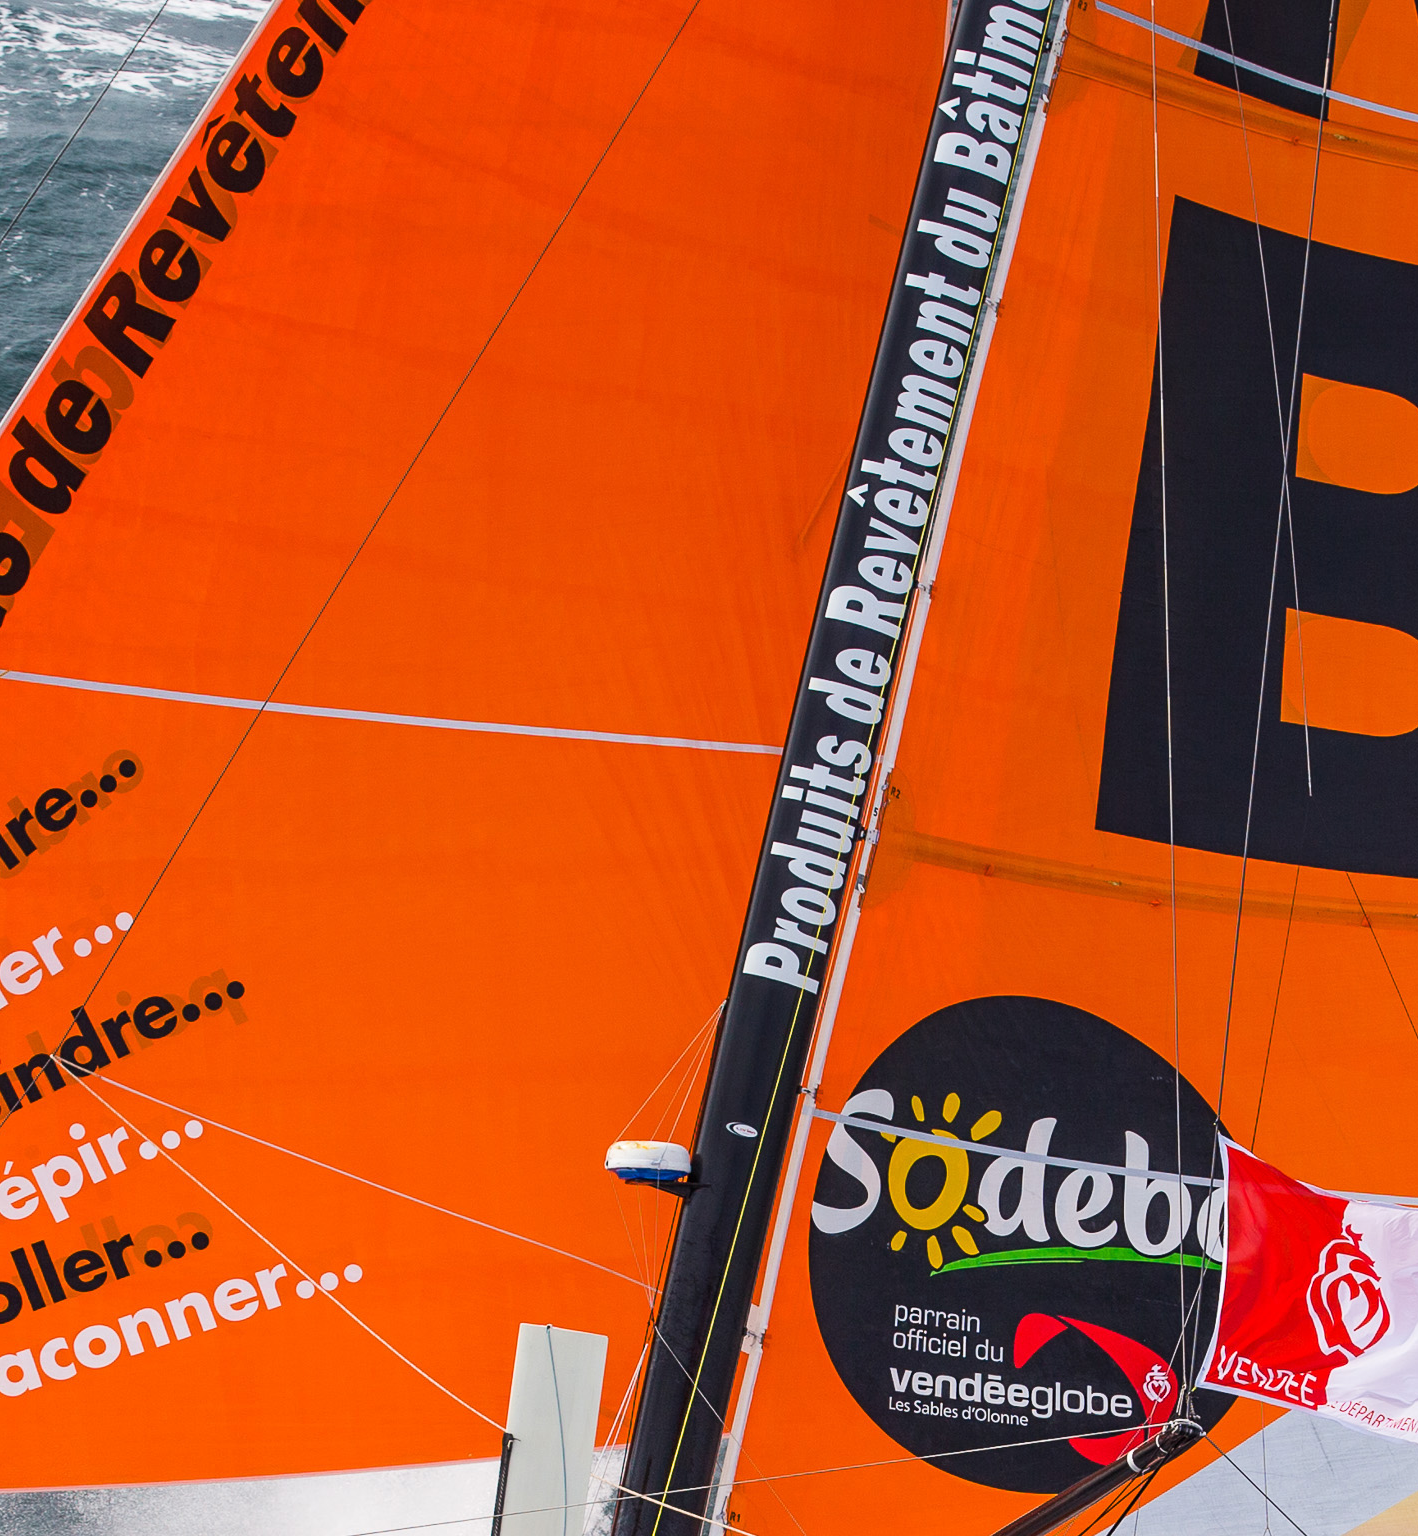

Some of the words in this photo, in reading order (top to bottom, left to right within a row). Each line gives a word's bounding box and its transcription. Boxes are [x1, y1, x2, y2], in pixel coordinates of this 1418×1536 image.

[934, 0, 1051, 185] Bâtim
[917, 187, 1001, 268] du
[8, 379, 113, 514] de
[825, 272, 981, 640] Revêtement
[808, 648, 891, 725] de
[743, 735, 871, 994] Produits
[893, 1331, 967, 1357] officiel
[975, 1339, 1004, 1362] du
[894, 1304, 980, 1332] parrain
[889, 1397, 910, 1413] Les
[914, 1400, 959, 1418] Sables
[962, 1406, 1028, 1426] d'Olonne
